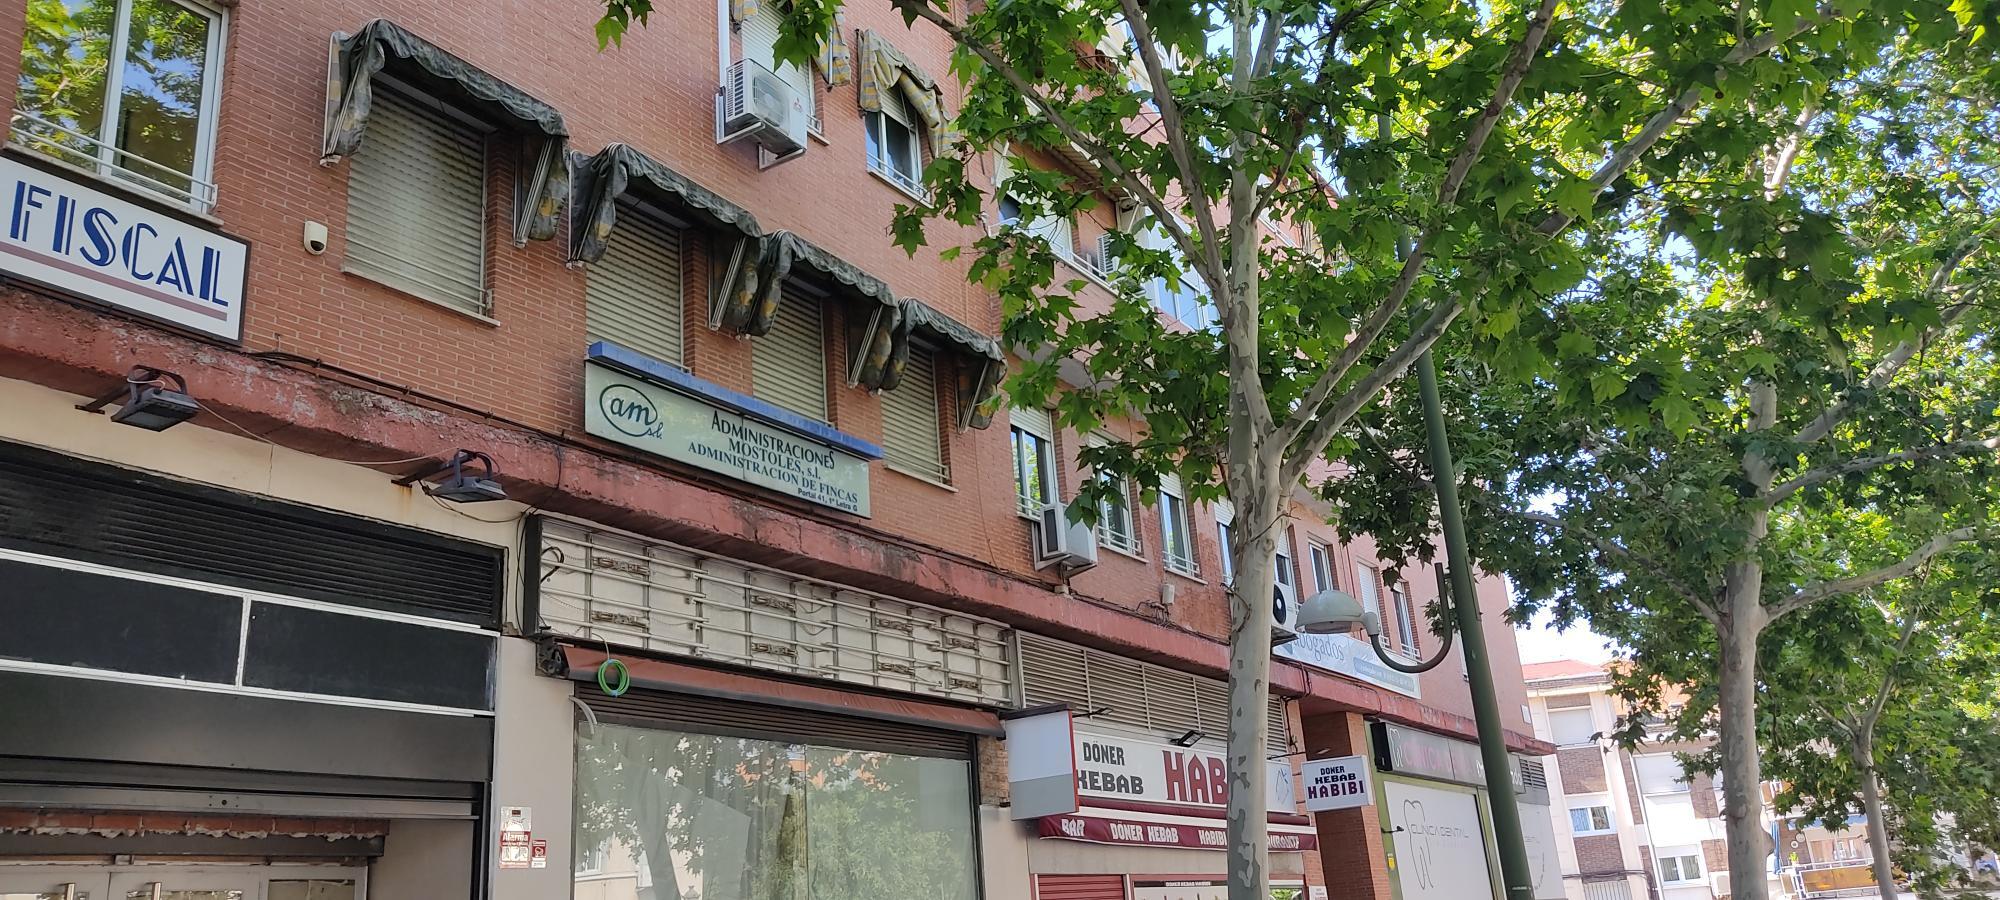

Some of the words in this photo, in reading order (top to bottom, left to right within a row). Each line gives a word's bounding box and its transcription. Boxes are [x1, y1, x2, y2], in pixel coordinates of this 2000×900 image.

[11, 181, 229, 307] FISCAL
[688, 441, 799, 486] ADMINISTRACION
[802, 480, 817, 491] DE
[820, 482, 858, 504] FINCAS
[798, 487, 816, 500] Portal
[1082, 740, 1125, 766] DÖNER
[1077, 769, 1144, 795] KEBAB
[1307, 780, 1365, 800] HABIBI
[1315, 772, 1357, 785] KEBAB
[1061, 818, 1085, 837] BAR
[1147, 825, 1179, 843] KEBAB
[1198, 829, 1227, 846] HABIBI
